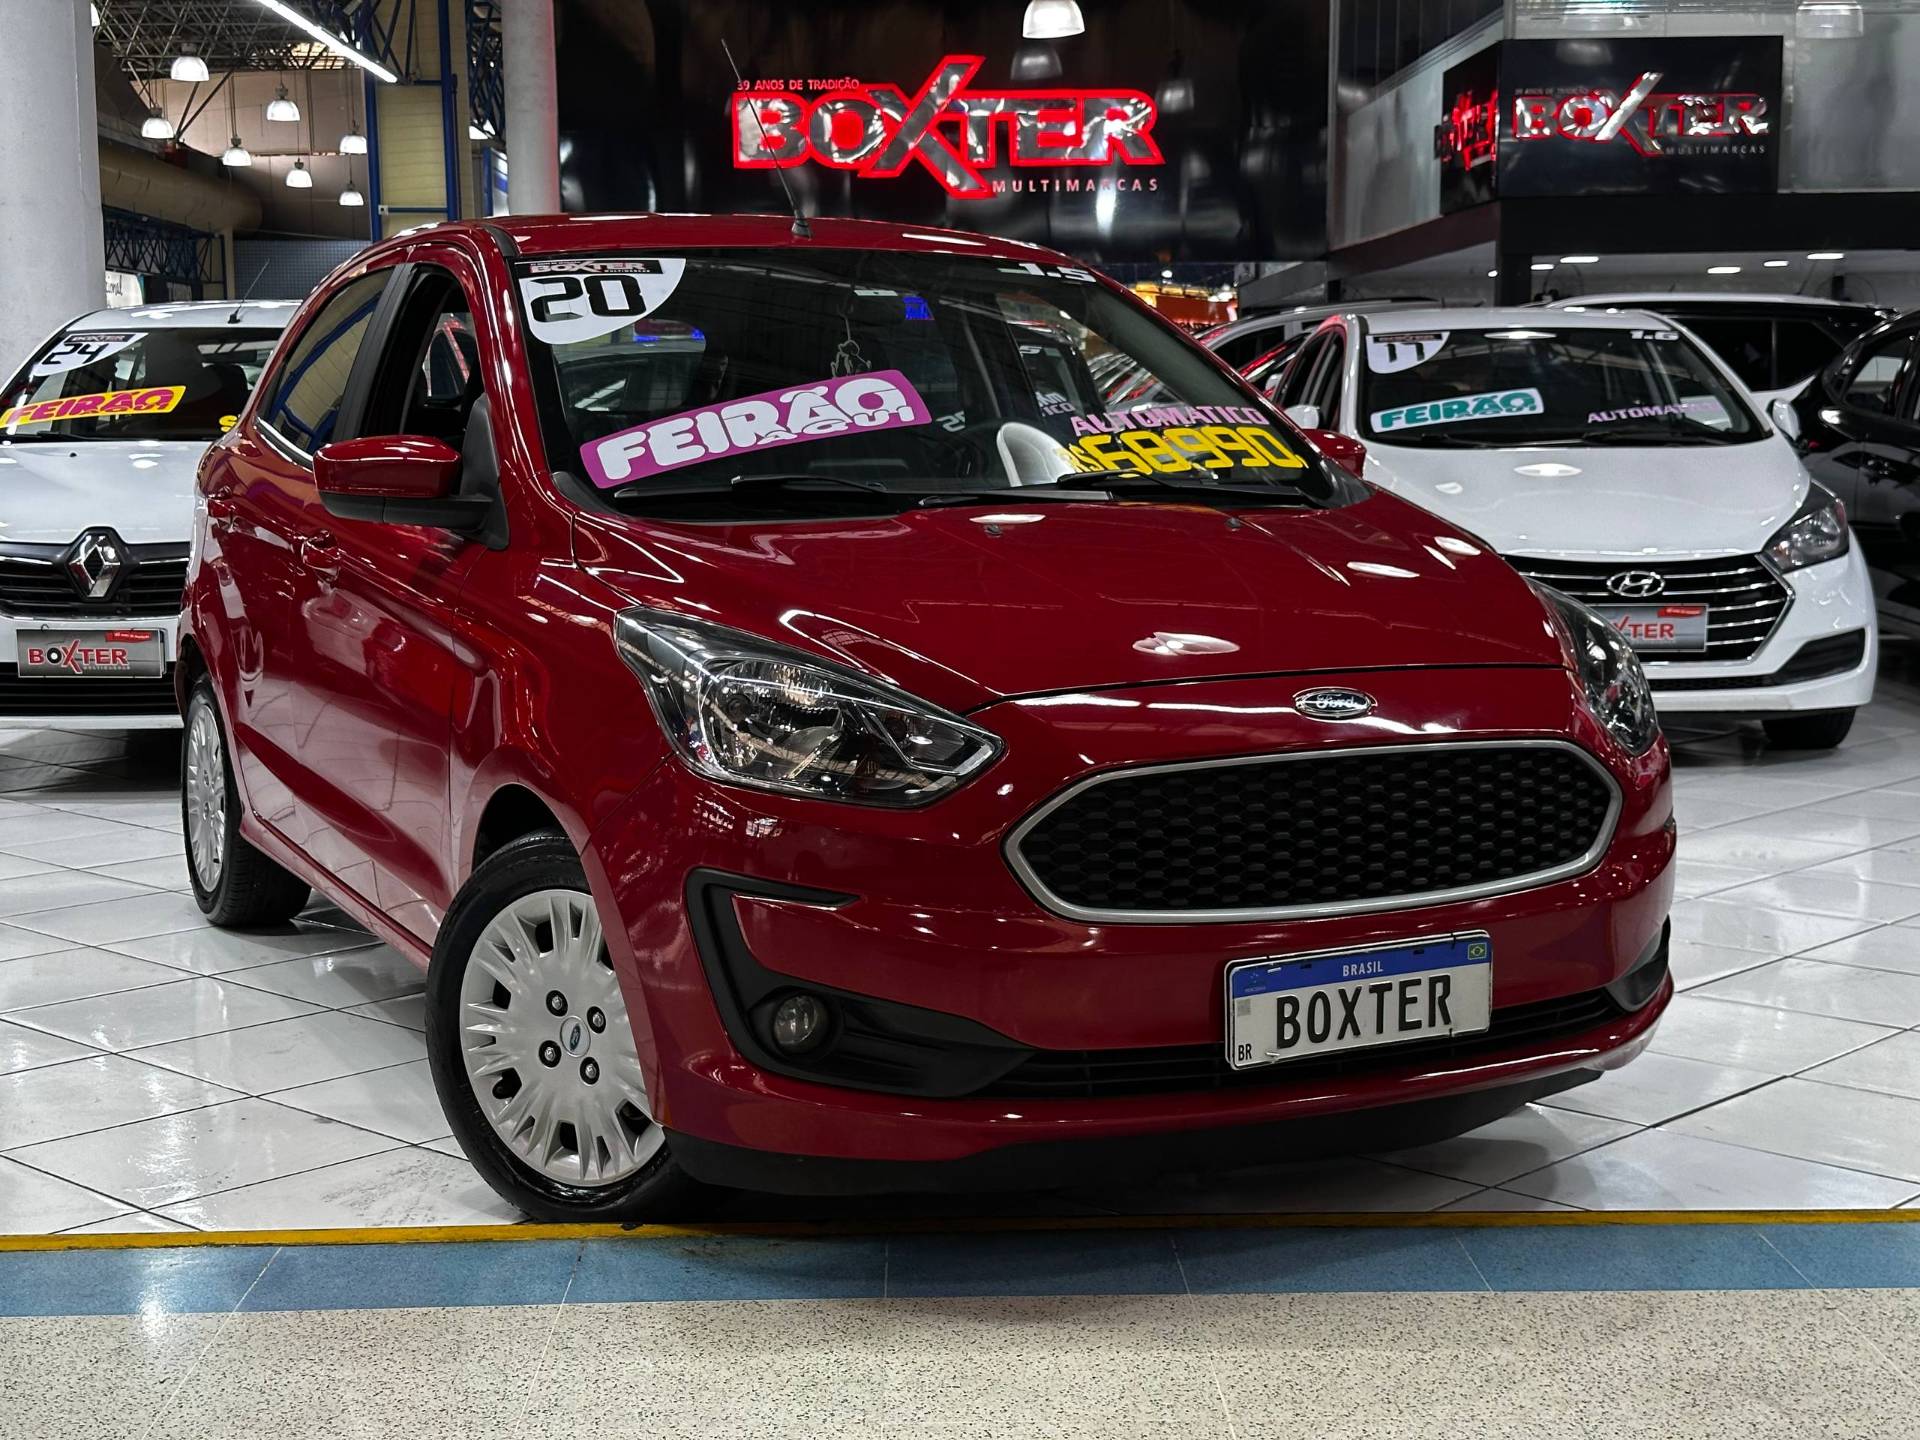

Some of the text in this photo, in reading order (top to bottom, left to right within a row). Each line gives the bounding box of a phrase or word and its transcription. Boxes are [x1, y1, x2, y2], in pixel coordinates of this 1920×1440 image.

[737, 76, 860, 91] 39 ANOS DE TRADIÇÃO
[1512, 71, 1769, 157] BOXTER
[733, 55, 1166, 199] BOXTER
[1663, 144, 1766, 156] MULTIMARCAS
[991, 179, 1159, 193] MULTIMARCAS
[529, 260, 645, 274] BOXTER
[530, 276, 648, 323] 20
[1629, 330, 1679, 341] 1.6
[42, 343, 110, 365] 24
[1380, 392, 1536, 429] FEIRÃO
[597, 378, 907, 480] FEIRÃO
[28, 639, 129, 675] BOXTER
[1342, 961, 1384, 977] BRASIL
[1276, 974, 1452, 1050] BOXTER
[1238, 1044, 1253, 1062] BR
